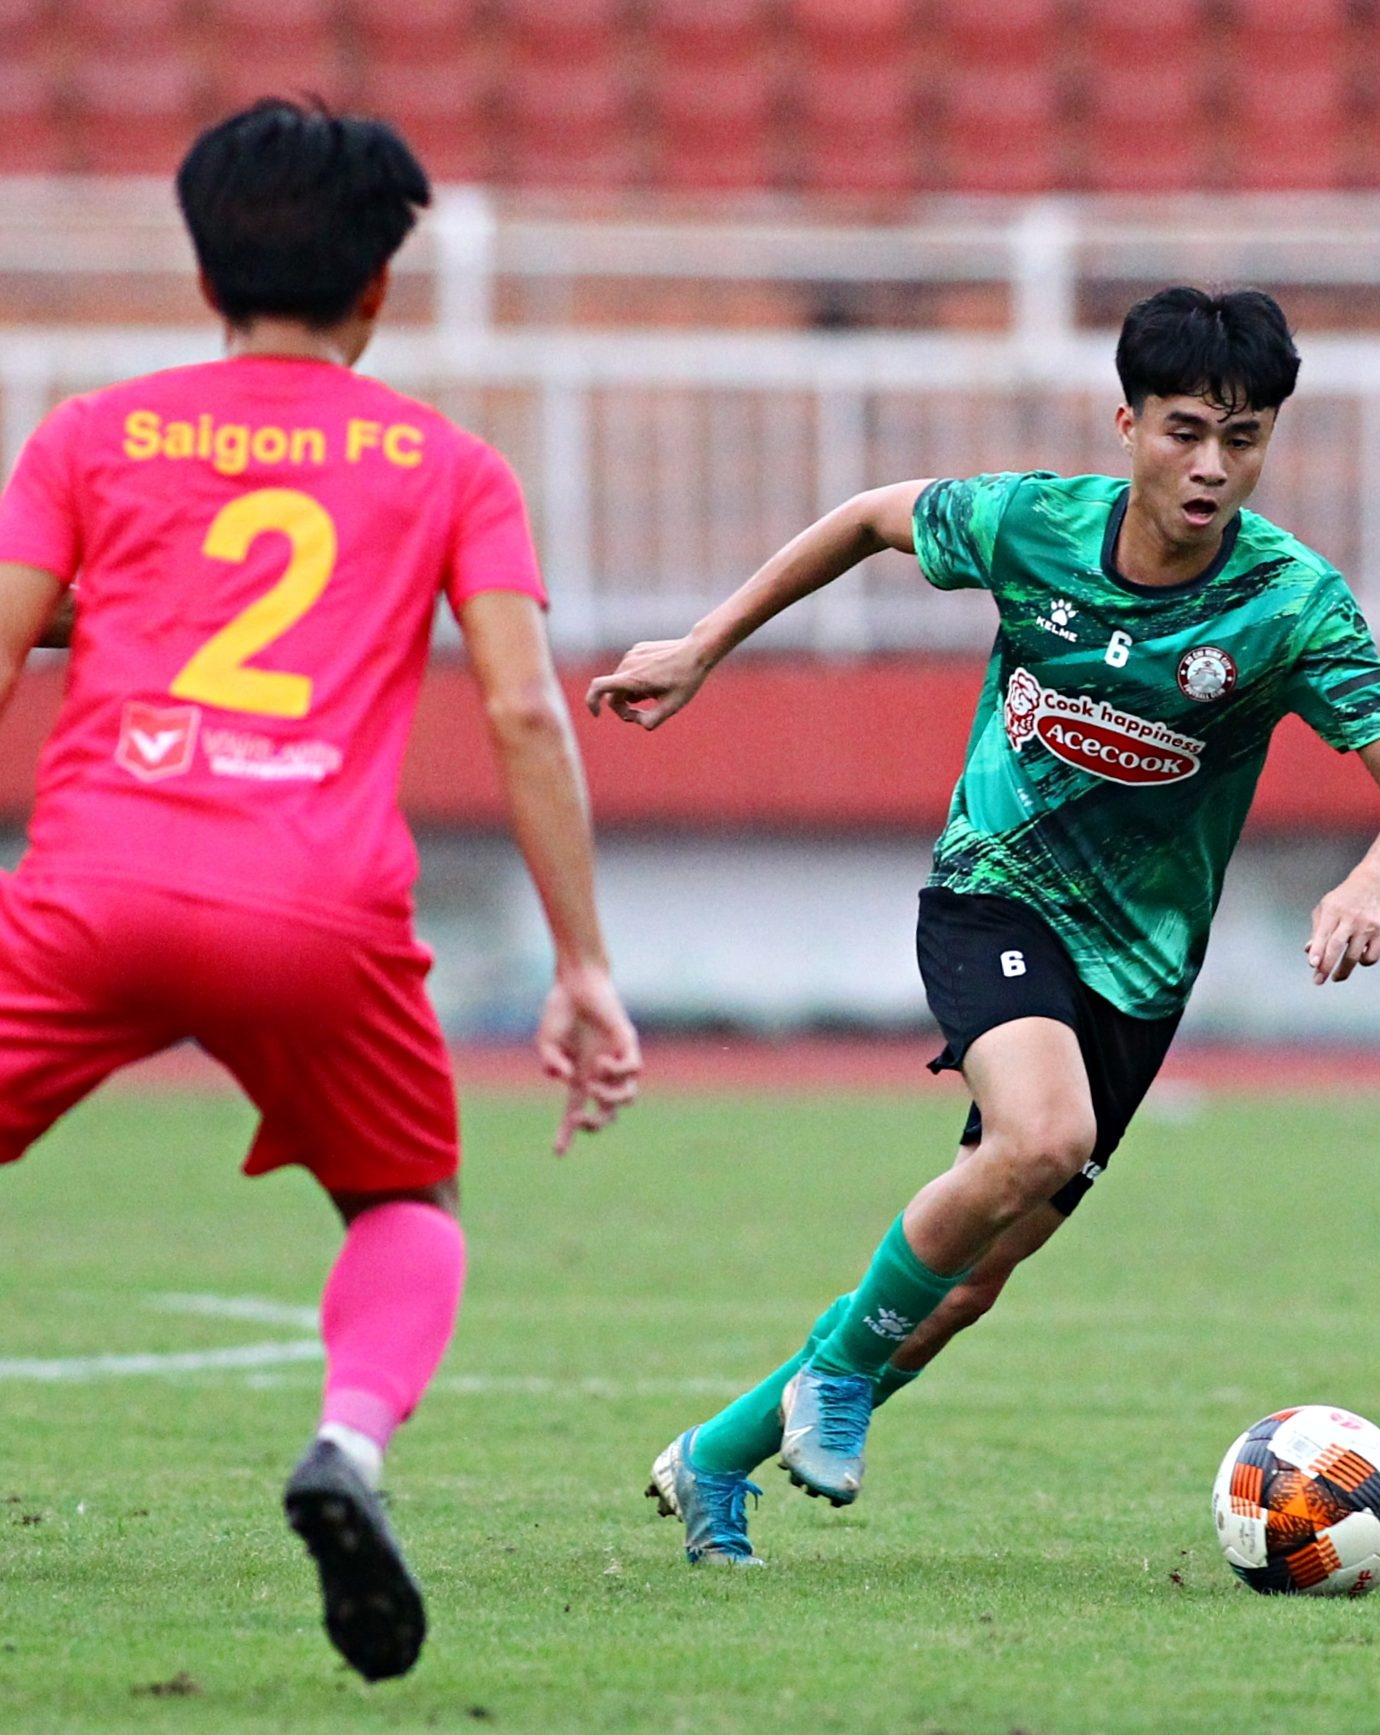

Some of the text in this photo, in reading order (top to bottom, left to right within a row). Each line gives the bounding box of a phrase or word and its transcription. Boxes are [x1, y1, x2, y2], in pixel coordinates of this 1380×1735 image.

[123, 410, 425, 475] Saigon FC
[169, 489, 338, 720] 2
[1036, 616, 1078, 643] KELME
[1104, 630, 1133, 668] 6
[1045, 694, 1202, 753] Cook happiness
[1000, 950, 1026, 977] 6
